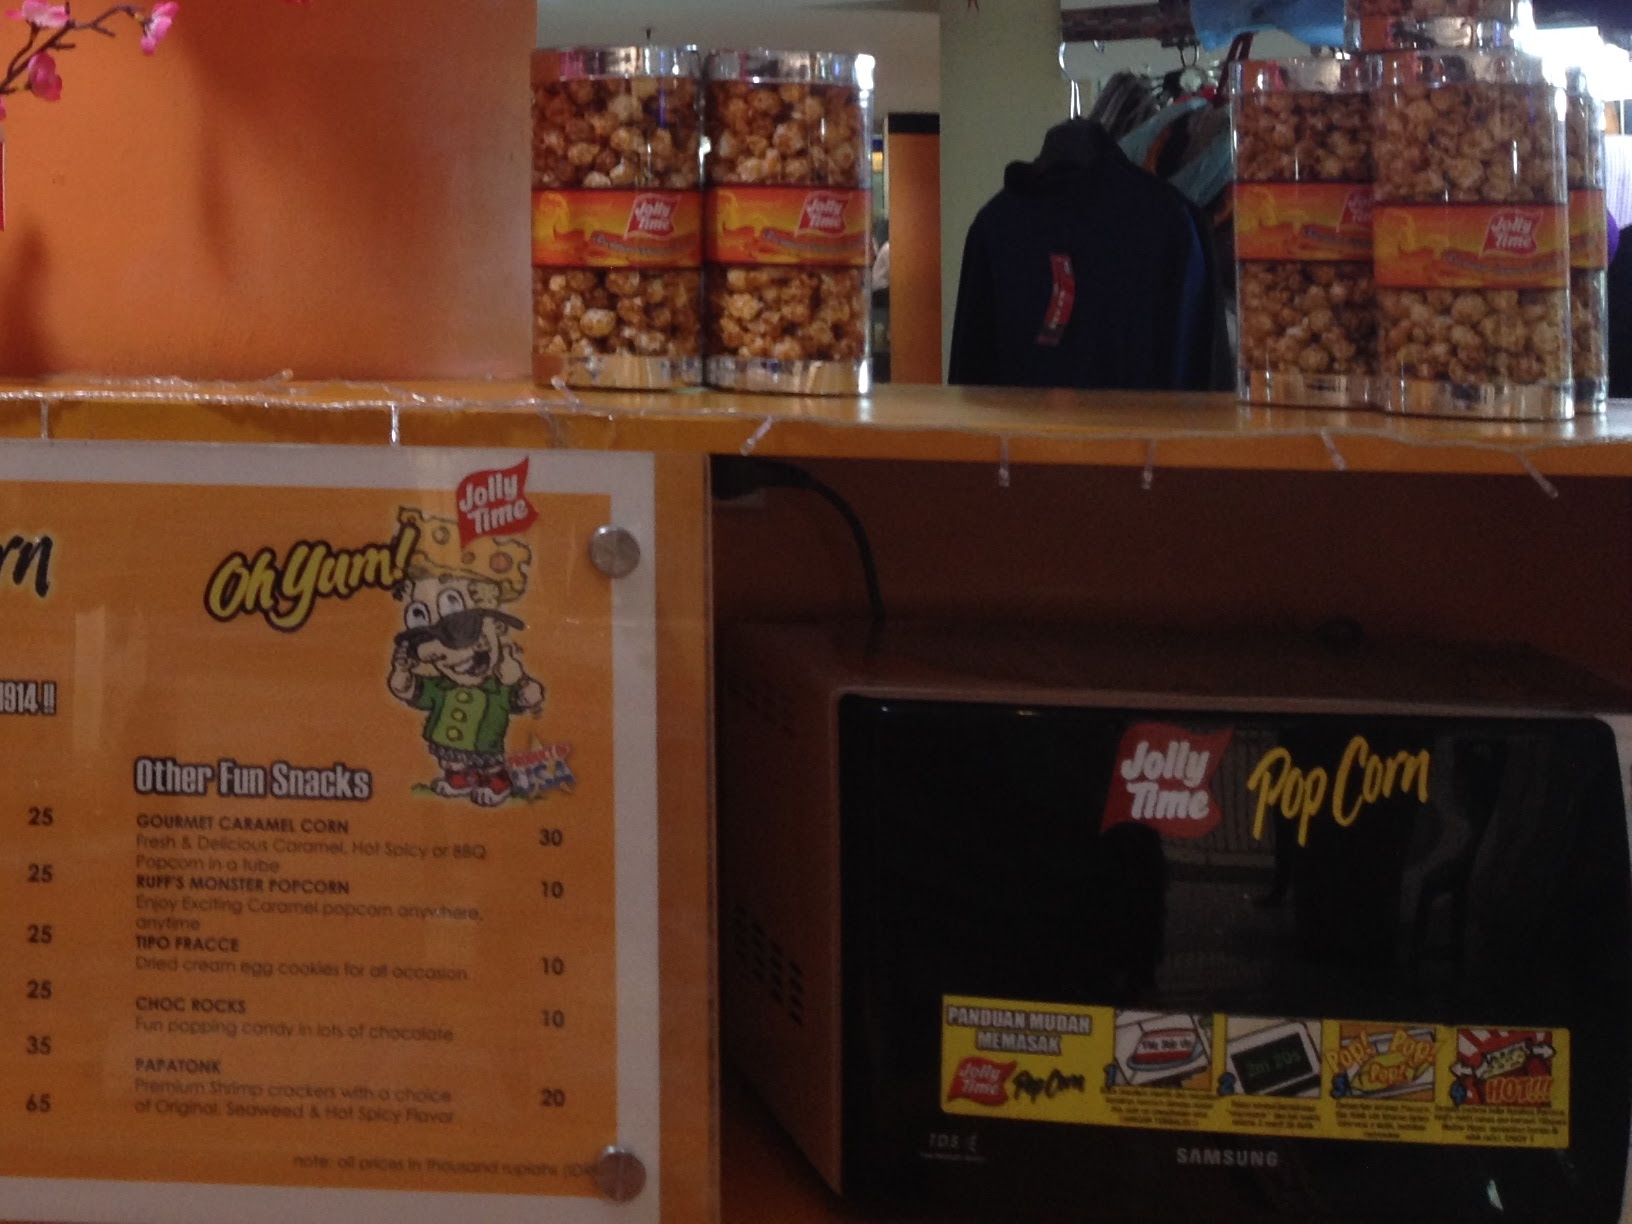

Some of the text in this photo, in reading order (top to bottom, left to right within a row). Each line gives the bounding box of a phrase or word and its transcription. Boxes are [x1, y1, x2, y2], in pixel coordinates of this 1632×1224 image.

[459, 472, 519, 514] Jolly
[468, 498, 529, 536] Time
[204, 522, 422, 634] Oh Yum!
[1120, 740, 1210, 788] Jolly
[134, 755, 373, 803] Other Fun Snacks
[1126, 781, 1210, 821] Time
[28, 806, 55, 827] 25
[136, 812, 350, 835] GOURMET CARAMEL CORN
[136, 834, 176, 851] Fresh
[196, 835, 268, 853] Delicious
[538, 828, 564, 848] 30
[27, 863, 54, 883] 25
[189, 876, 265, 893] MONSTER
[269, 878, 351, 895] POPCORN
[540, 880, 565, 900] 10
[27, 925, 54, 945] 25
[540, 956, 566, 976] 10
[26, 979, 53, 1001] 25
[135, 996, 248, 1015] CHOC ROCKS
[541, 1009, 566, 1030] 10
[946, 1005, 1093, 1036] PANDUAN MUDAH
[25, 1034, 53, 1056] 35
[975, 1029, 1061, 1056] MEMASAK
[24, 1093, 53, 1114] 65
[539, 1087, 566, 1108] 20
[1176, 1146, 1279, 1168] SAMSUNG
